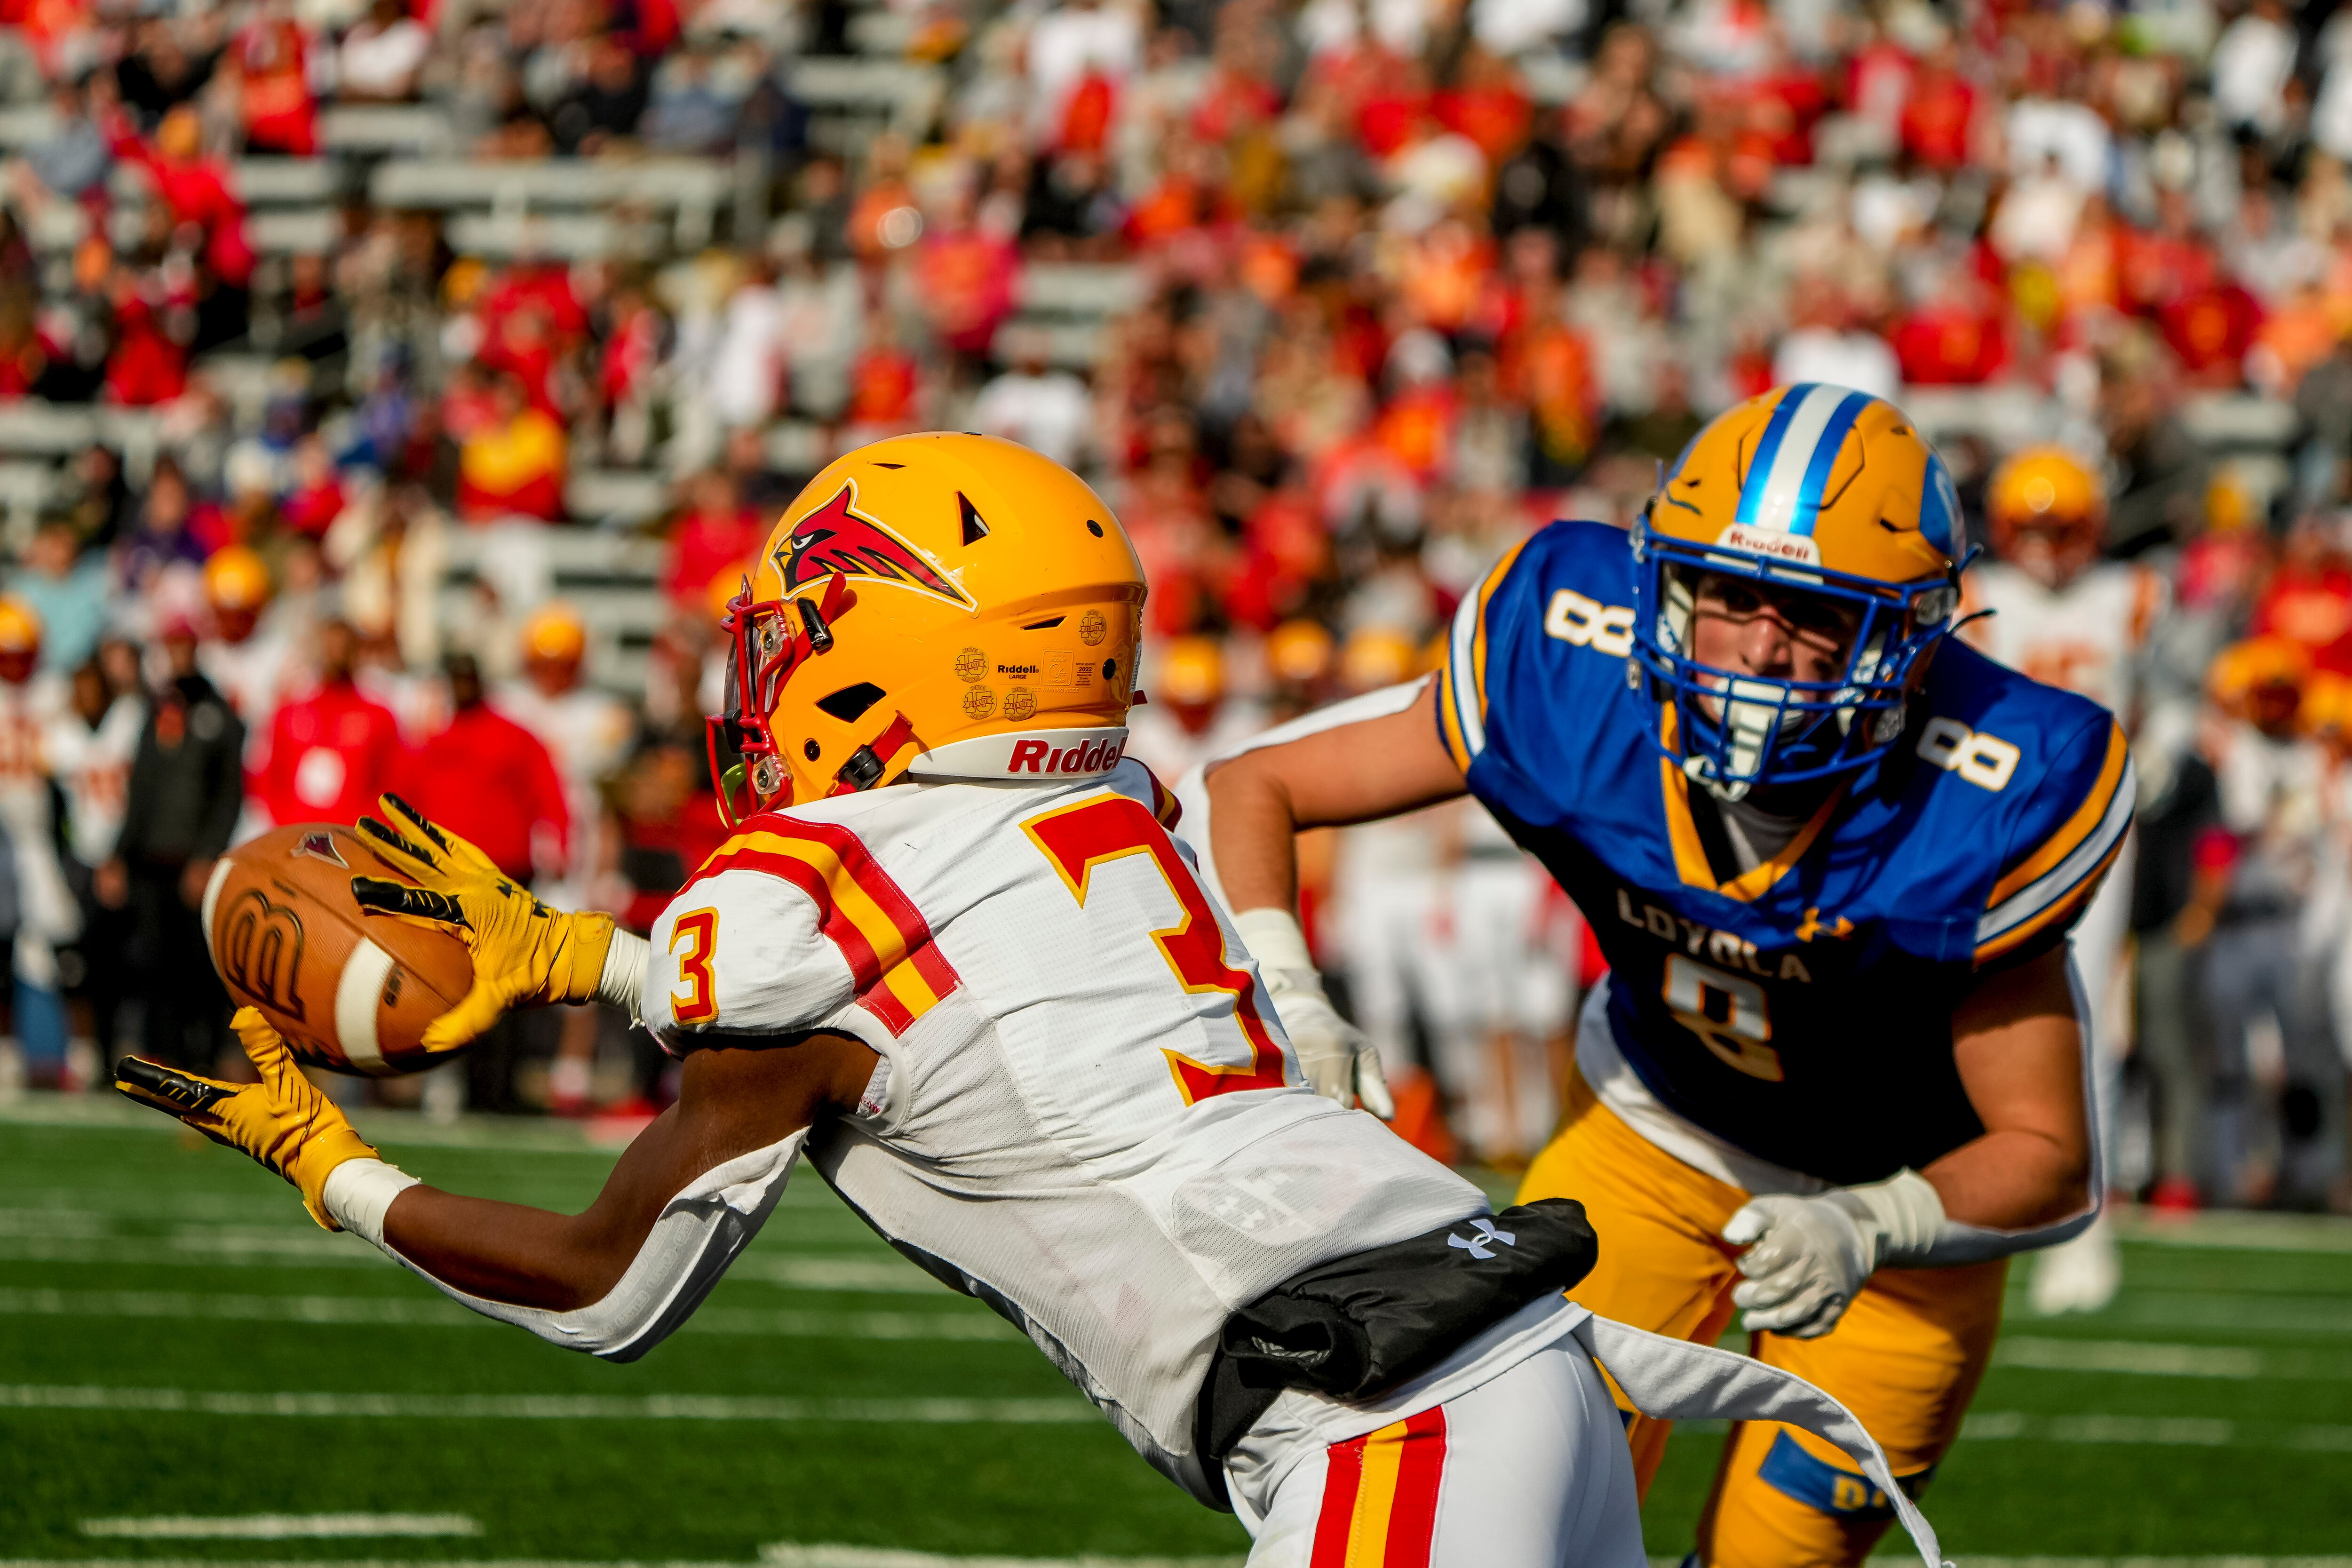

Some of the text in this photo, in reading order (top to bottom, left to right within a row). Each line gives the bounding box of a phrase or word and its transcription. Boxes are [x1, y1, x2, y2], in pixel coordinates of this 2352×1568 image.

[1081, 617, 1103, 638] 15
[1544, 588, 1636, 658] 8
[957, 653, 984, 676] 15
[998, 665, 1036, 673] Riddell
[965, 691, 992, 713] 15
[1006, 693, 1033, 715] 15
[1916, 715, 2021, 792] 8
[669, 906, 721, 1026] 3
[1018, 791, 1289, 1107] 3
[1617, 888, 1812, 983] LOYOLA
[1661, 952, 1785, 1082] 8
